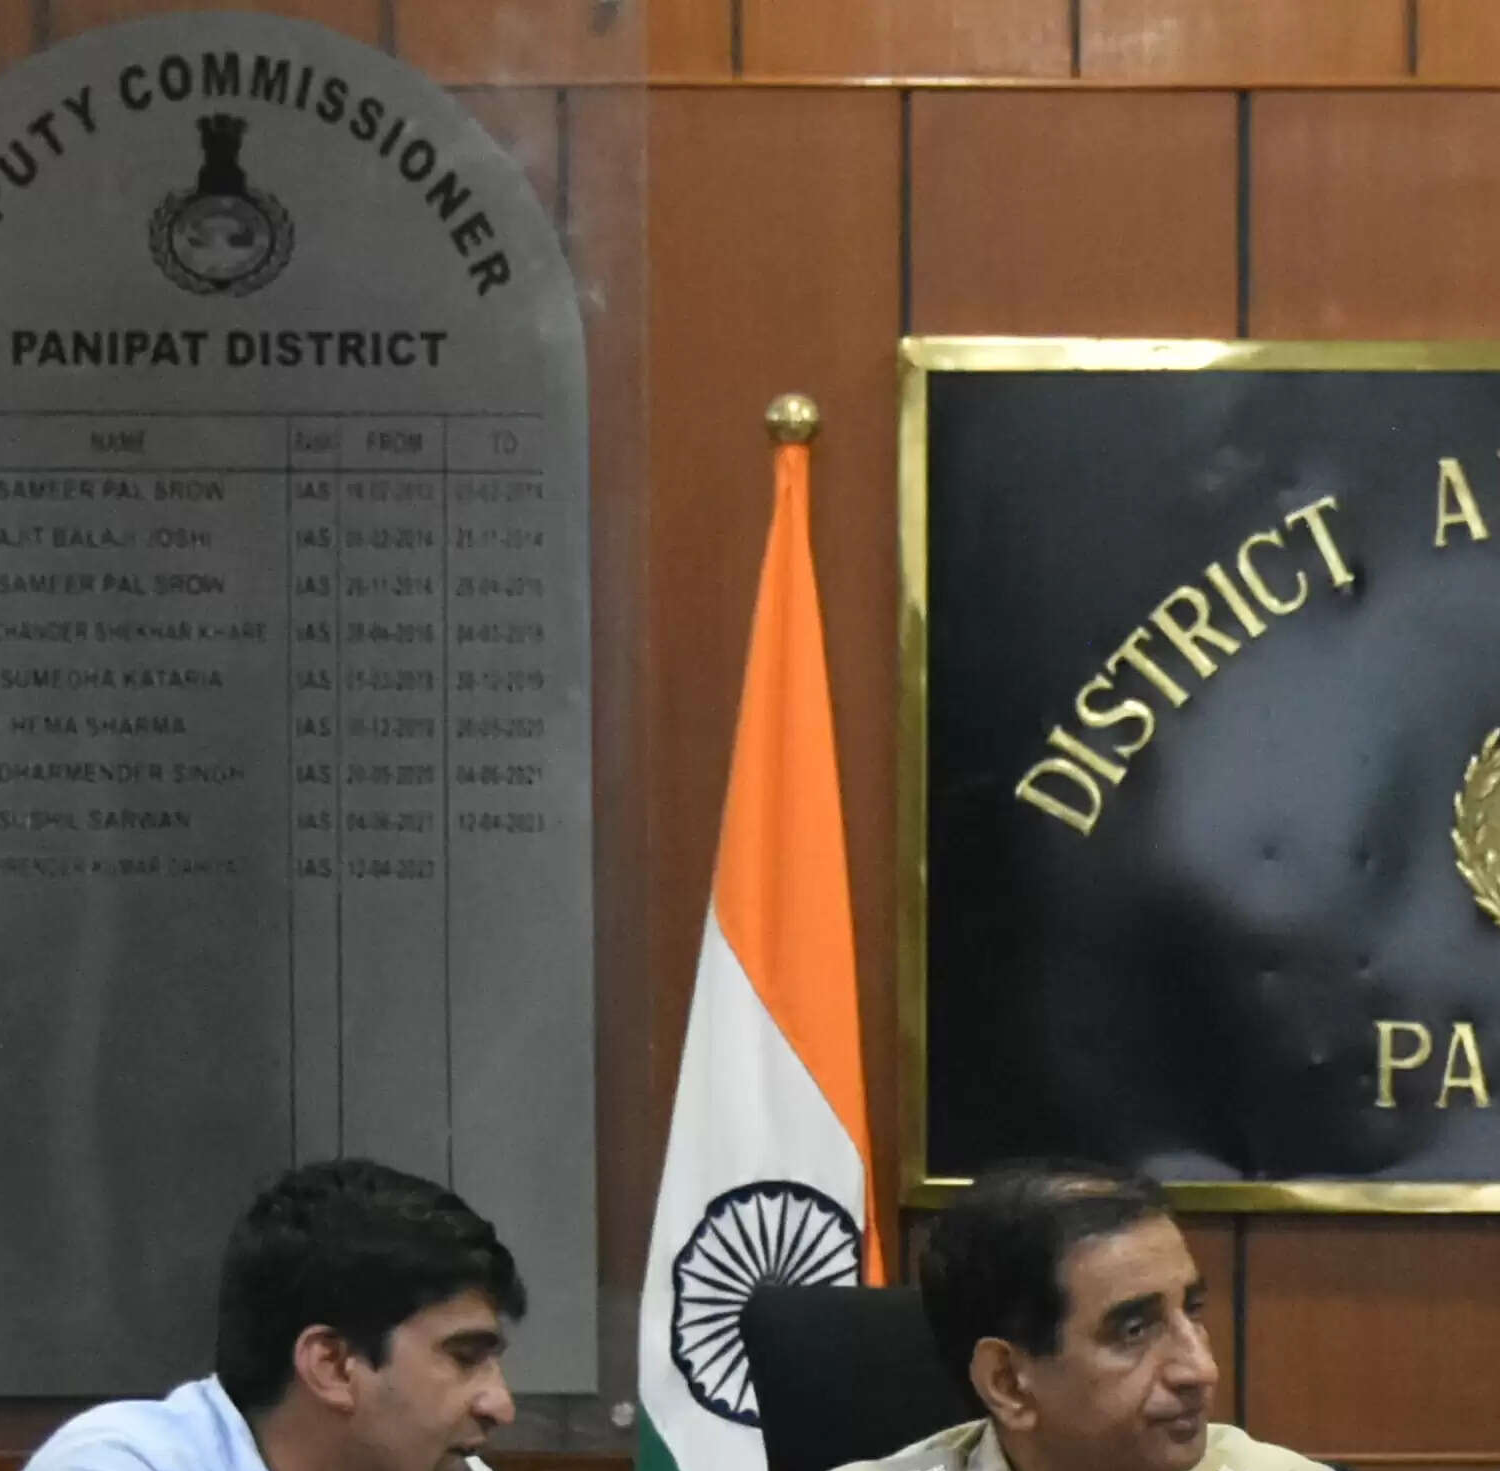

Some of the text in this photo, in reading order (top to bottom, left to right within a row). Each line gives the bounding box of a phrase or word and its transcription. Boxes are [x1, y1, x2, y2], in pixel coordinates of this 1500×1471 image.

[118, 50, 513, 298] COMMISSIONER
[11, 330, 447, 368] PANIPAT DISTRICT
[1015, 496, 1359, 837] DISTRICT
